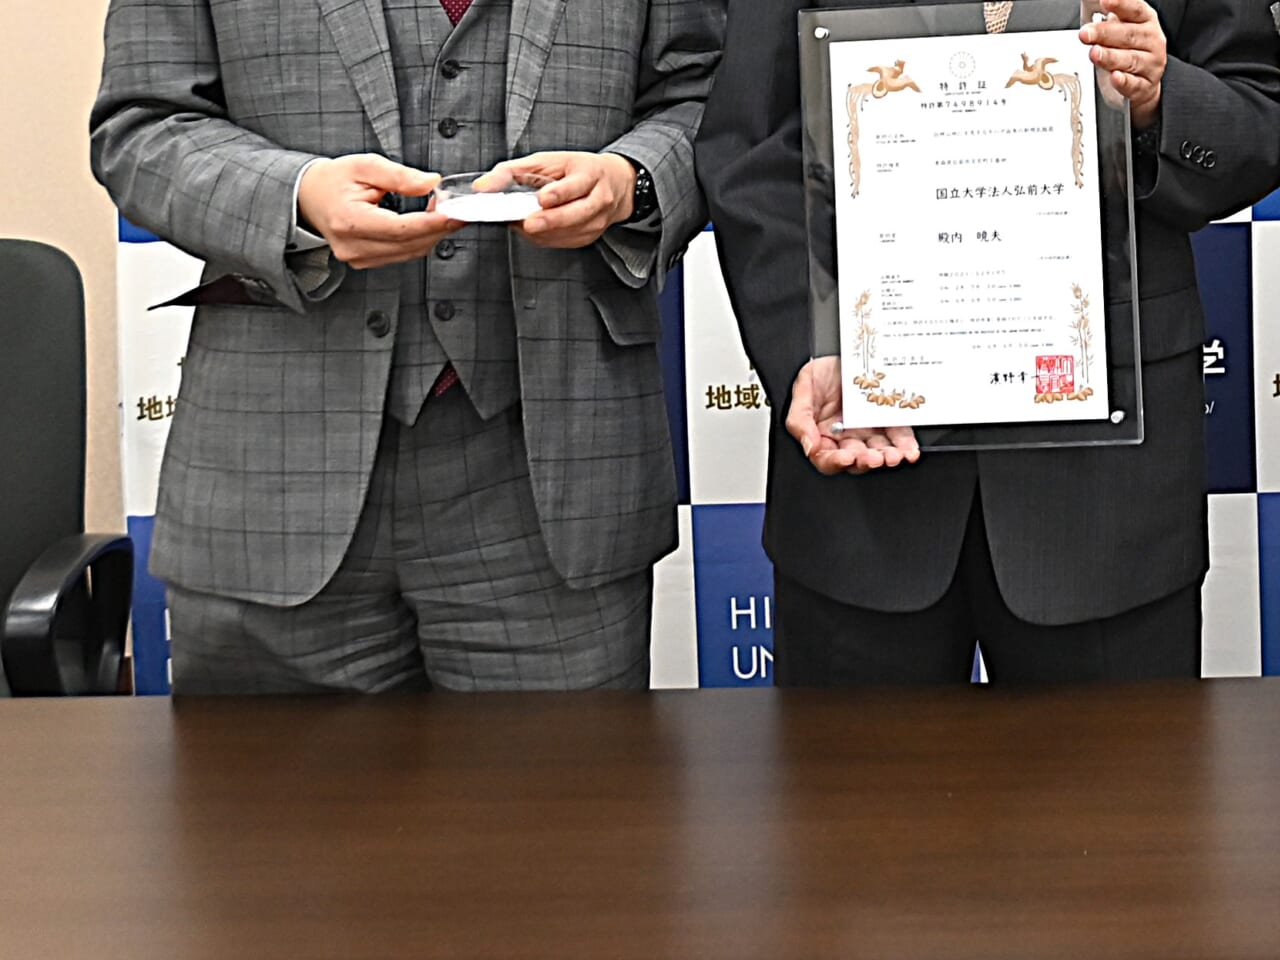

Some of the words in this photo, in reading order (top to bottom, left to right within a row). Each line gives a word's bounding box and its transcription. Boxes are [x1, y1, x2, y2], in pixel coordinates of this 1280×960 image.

[936, 183, 1065, 200] 国立大学法人弘前大学
